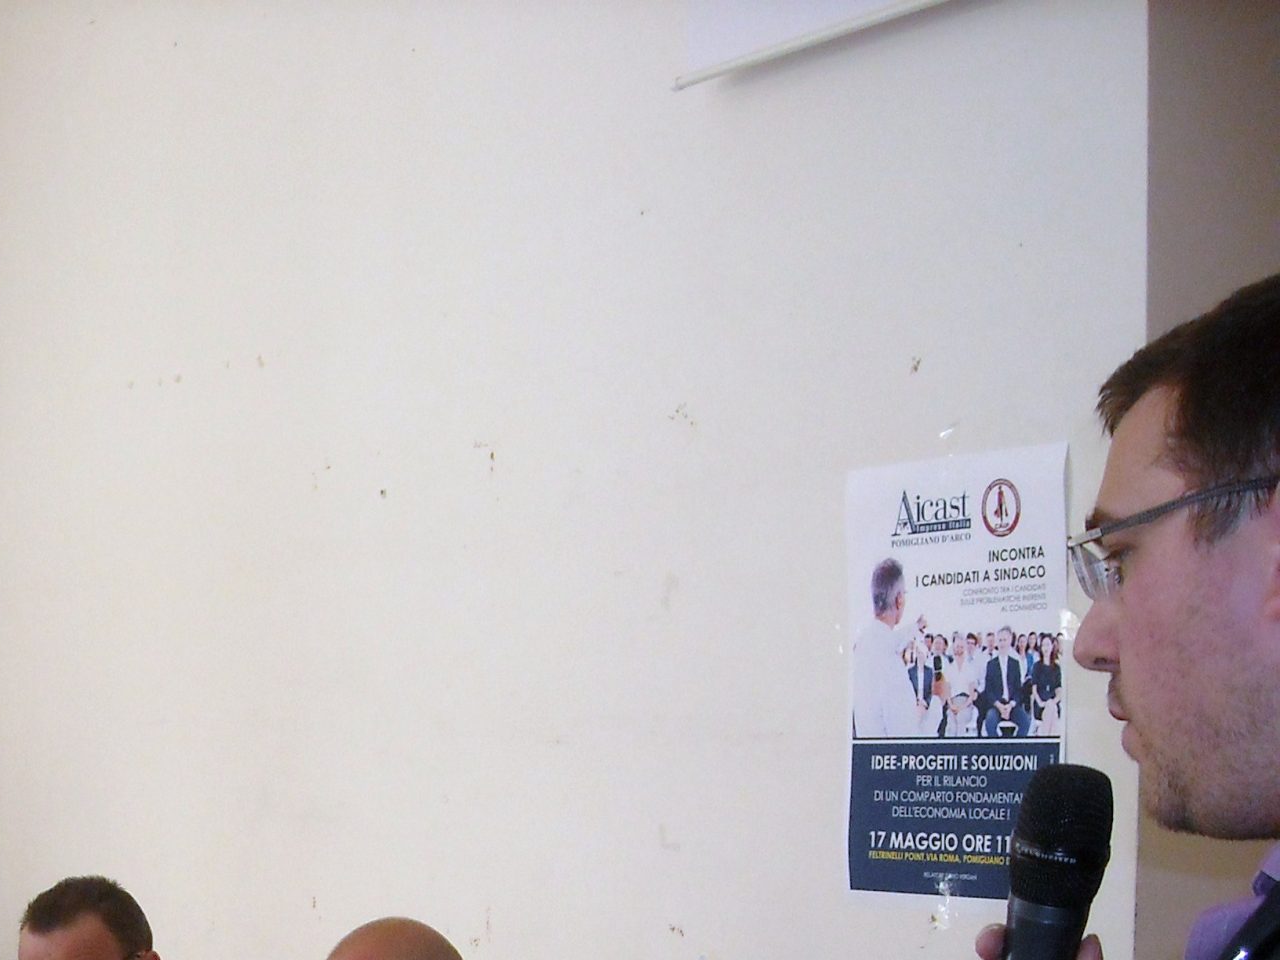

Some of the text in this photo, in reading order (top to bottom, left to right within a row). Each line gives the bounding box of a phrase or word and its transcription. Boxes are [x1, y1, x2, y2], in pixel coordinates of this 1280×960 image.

[891, 489, 970, 536] Aicast
[891, 533, 971, 548] POMIGLIANO D'ARCO
[988, 545, 1045, 563] INCONTRA
[922, 570, 979, 587] CANDIDATI
[983, 570, 990, 581] A
[994, 565, 1046, 581] SINDACO
[871, 754, 958, 770] IDEE-PROGETTI
[961, 755, 968, 770] E
[971, 755, 1038, 771] SOLUZIONI
[916, 775, 987, 787] PER IL RILANCIO
[874, 791, 883, 802] DI
[885, 791, 898, 802] UN
[900, 791, 954, 803] COMPARTO
[892, 806, 966, 819] DELL'ECONOMIA
[969, 808, 1006, 820] LOCALE
[869, 831, 886, 848] 17
[890, 832, 958, 851] MAGGIO
[962, 834, 992, 853] ORE
[868, 850, 904, 860] FELTRINELLI
